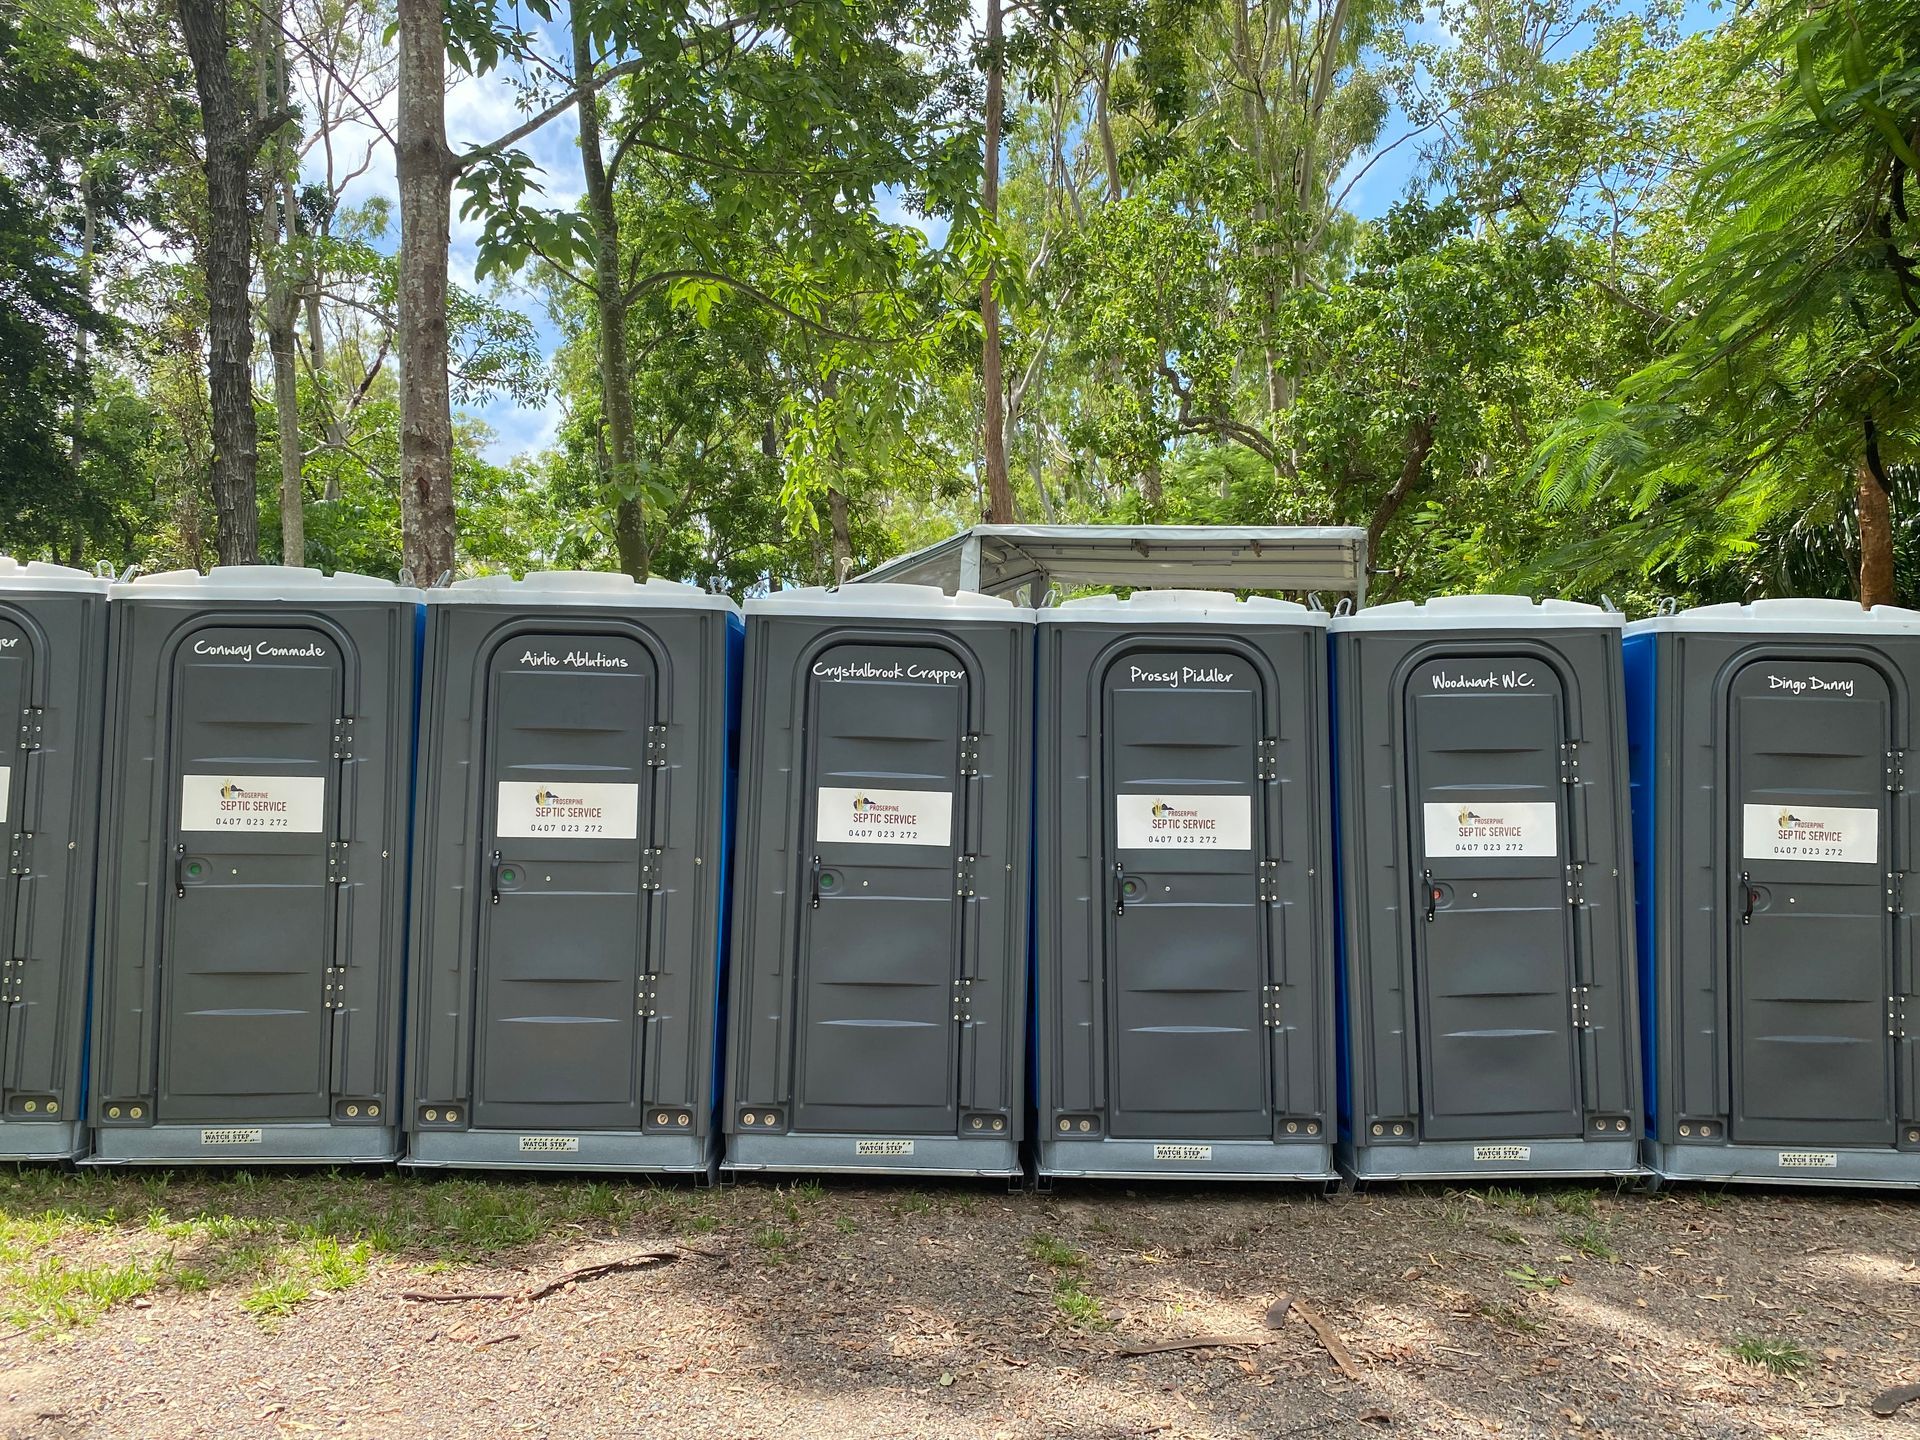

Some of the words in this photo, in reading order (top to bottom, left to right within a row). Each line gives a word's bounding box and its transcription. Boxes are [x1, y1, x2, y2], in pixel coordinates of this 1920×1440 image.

[194, 640, 251, 661] Conway
[256, 641, 325, 656] Commode
[520, 651, 559, 666] Airlie
[563, 651, 628, 667] Ablutions
[813, 662, 904, 680] Crystalbrook
[906, 664, 966, 683] Crapper
[1129, 666, 1179, 688] Prossy
[1182, 666, 1234, 683] Piddler
[1433, 672, 1499, 689] Woodwark
[1502, 671, 1535, 688] W.C.
[1768, 675, 1806, 694] Dingo
[1809, 676, 1853, 696] Dunny
[221, 801, 250, 811] SEPTIC
[253, 801, 286, 811] SERVICE
[552, 797, 583, 805] PROSERPINE
[536, 807, 565, 817] SEPTIC
[568, 808, 601, 818] SERVICE
[870, 804, 899, 812] PROSERPINE
[853, 813, 881, 823] SEPTIC
[884, 814, 916, 824] SERVICE
[1152, 819, 1180, 829] SEPTIC
[1183, 819, 1215, 829] SERVICE
[1794, 820, 1824, 828] PROSERPINE
[1459, 827, 1486, 837] SEPTIC
[1489, 827, 1521, 836] SERVICE
[1778, 830, 1806, 840] SEPTIC
[1809, 831, 1842, 841] SERVICE
